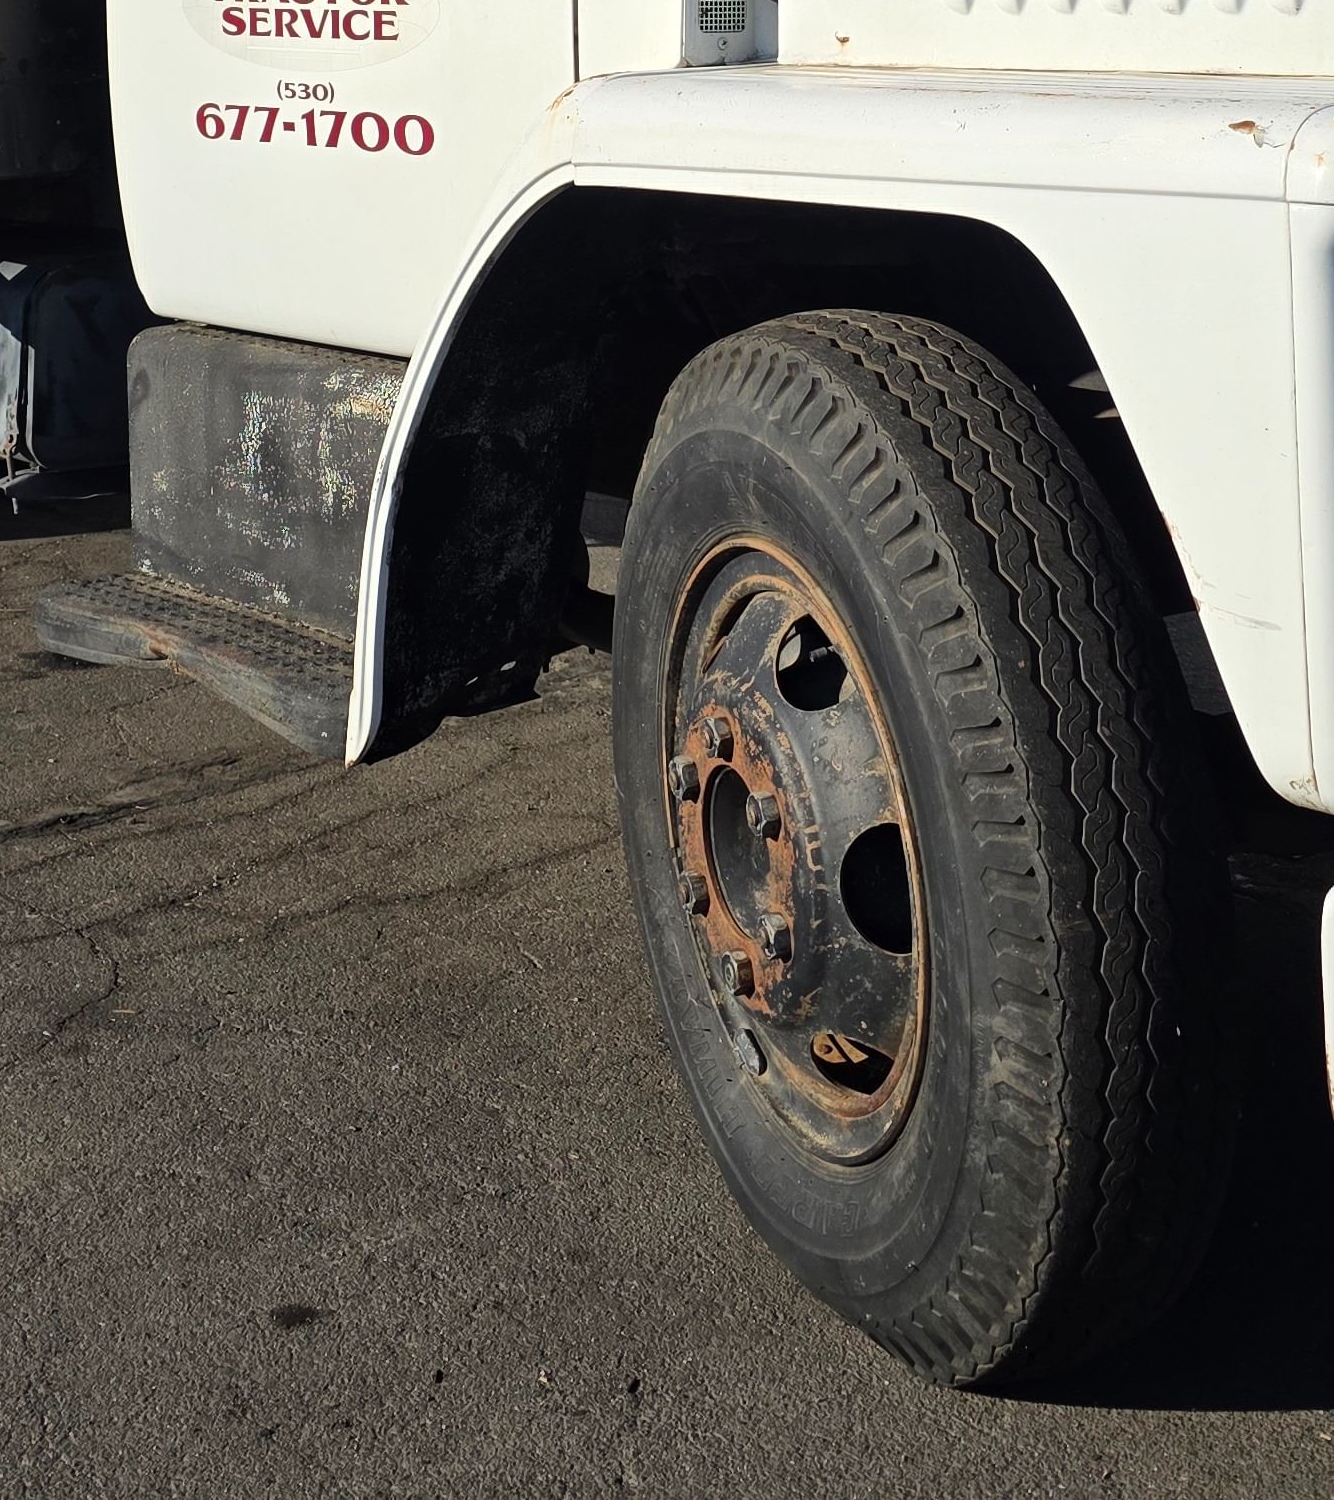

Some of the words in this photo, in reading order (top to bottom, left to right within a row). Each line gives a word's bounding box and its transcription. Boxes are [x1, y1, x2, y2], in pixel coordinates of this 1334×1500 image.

[221, 6, 400, 41] SERVICE
[276, 79, 335, 104] (530)
[195, 102, 435, 156] 677-1700
